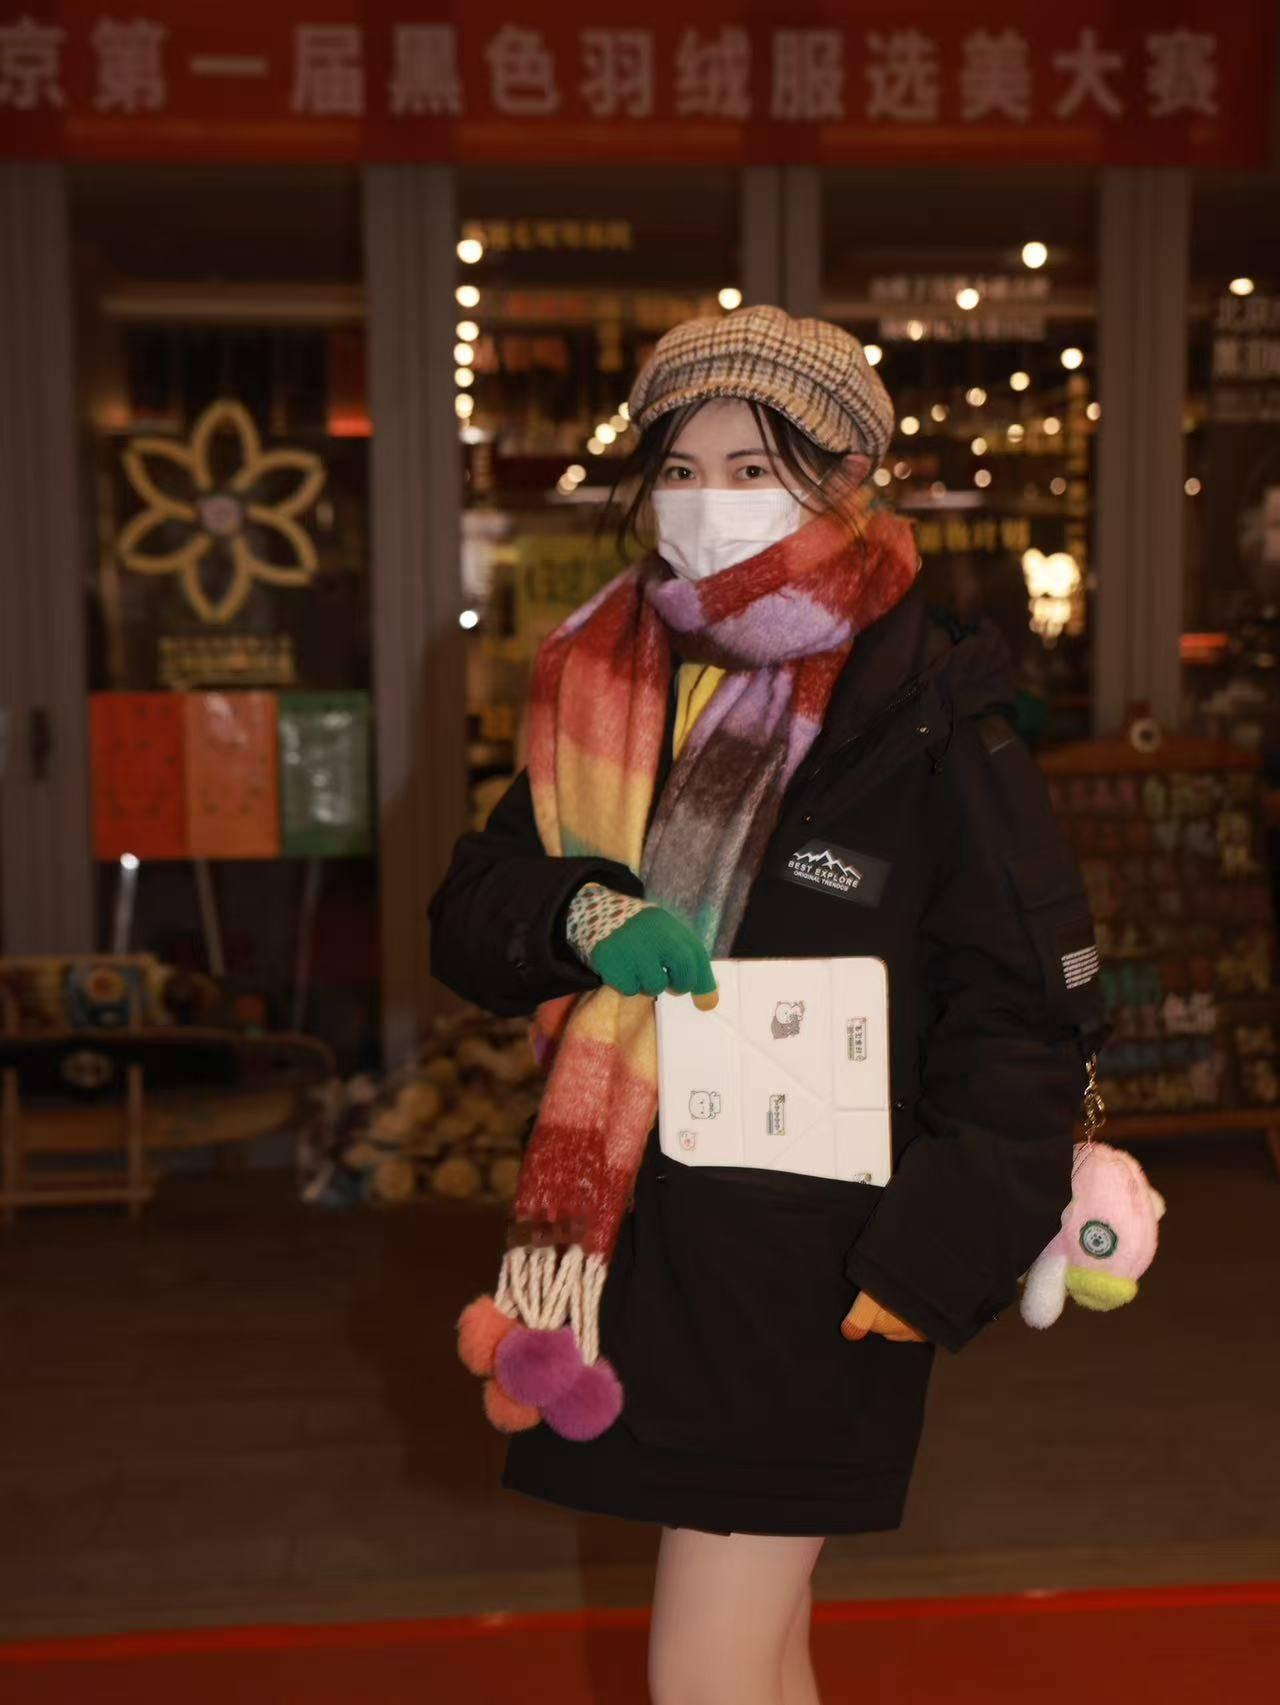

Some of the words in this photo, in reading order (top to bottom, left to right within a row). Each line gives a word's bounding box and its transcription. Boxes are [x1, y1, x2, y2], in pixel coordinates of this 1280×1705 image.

[0, 17, 1220, 121] 京第一届黑色羽绒服选美大赛
[788, 860, 812, 873] BEST
[815, 868, 859, 888] EXPLORE
[793, 870, 820, 883] ORIGINAL
